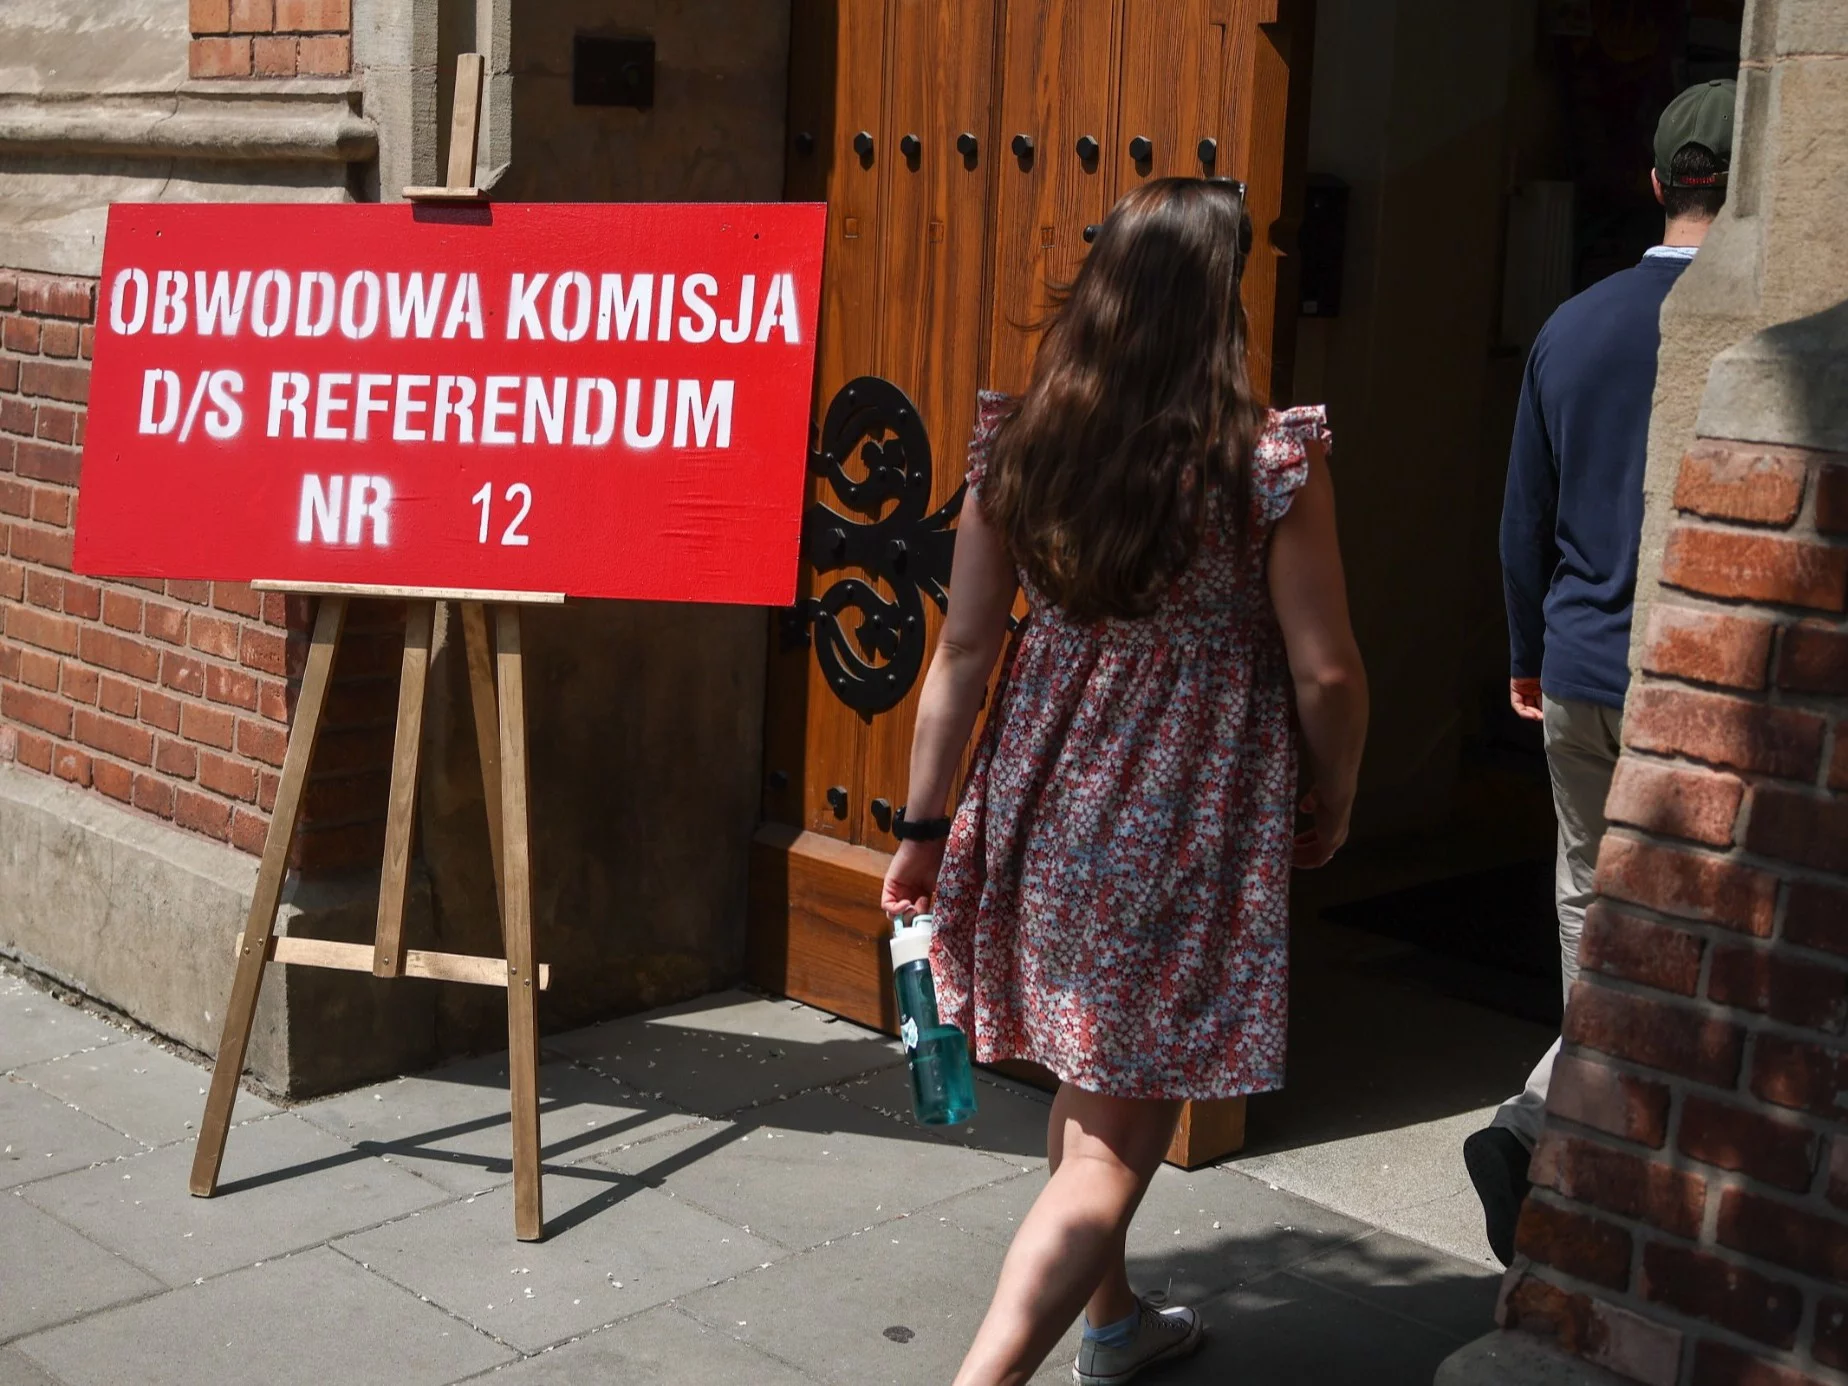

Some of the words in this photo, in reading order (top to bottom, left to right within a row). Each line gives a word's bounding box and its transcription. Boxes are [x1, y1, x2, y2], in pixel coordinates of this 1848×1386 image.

[108, 267, 484, 341] OBWODOWA
[506, 272, 801, 345] KOMISJA
[138, 368, 244, 443] D/S
[266, 371, 735, 449] REFERENDUM
[297, 473, 394, 548] NR
[471, 481, 532, 546] 12
